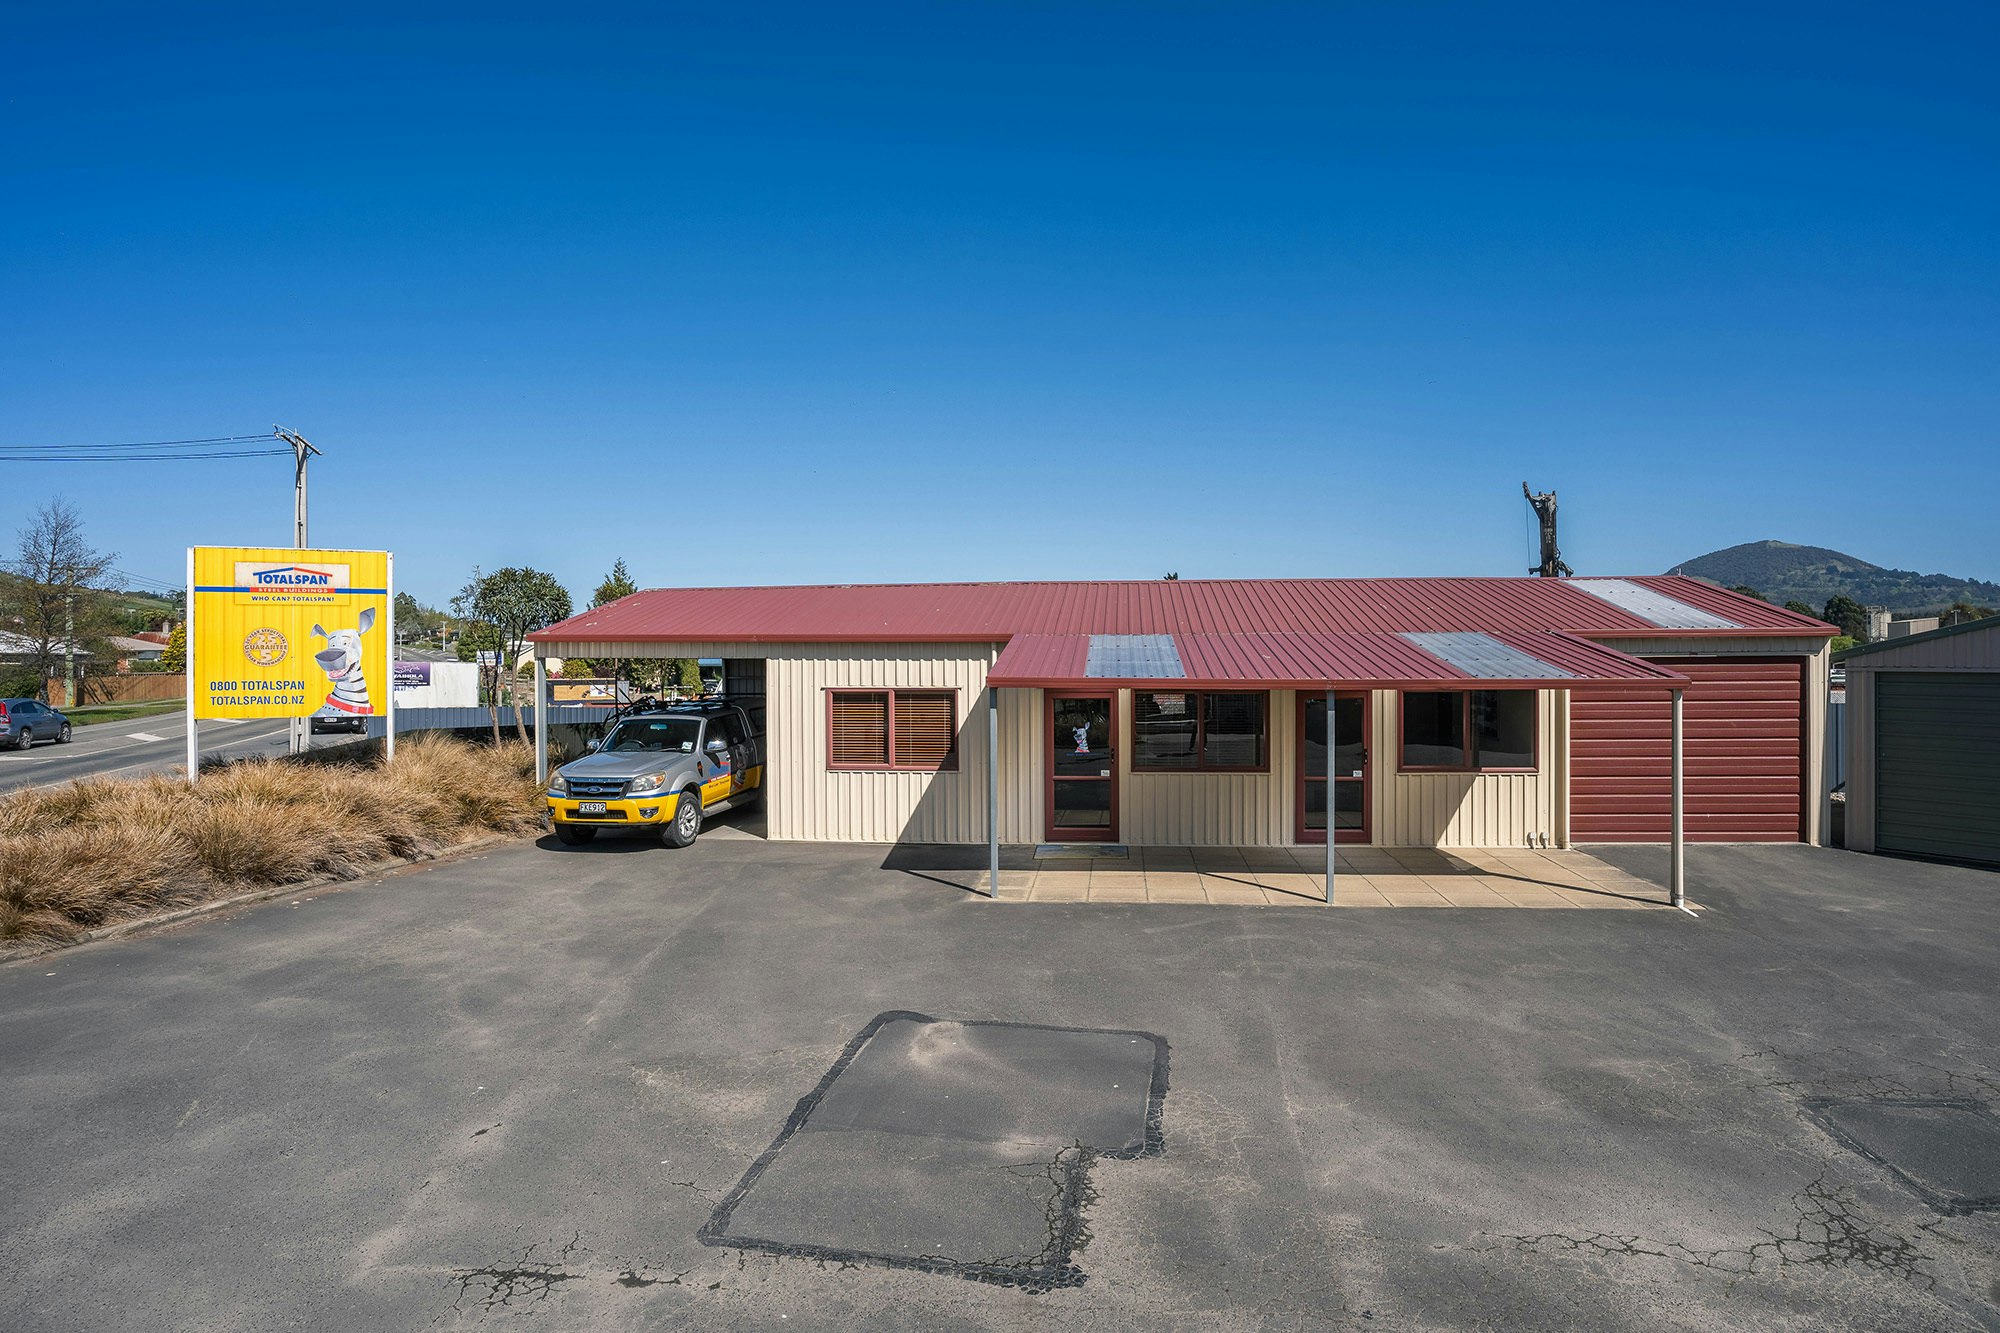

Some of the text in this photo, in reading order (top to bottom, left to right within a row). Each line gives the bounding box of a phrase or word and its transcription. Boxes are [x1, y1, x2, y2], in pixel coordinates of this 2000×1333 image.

[256, 573, 328, 584] TOTALSPAN
[210, 680, 305, 691] 0800 TOTALSPAN
[210, 695, 305, 706] TOTALSPAN.CO.NZ
